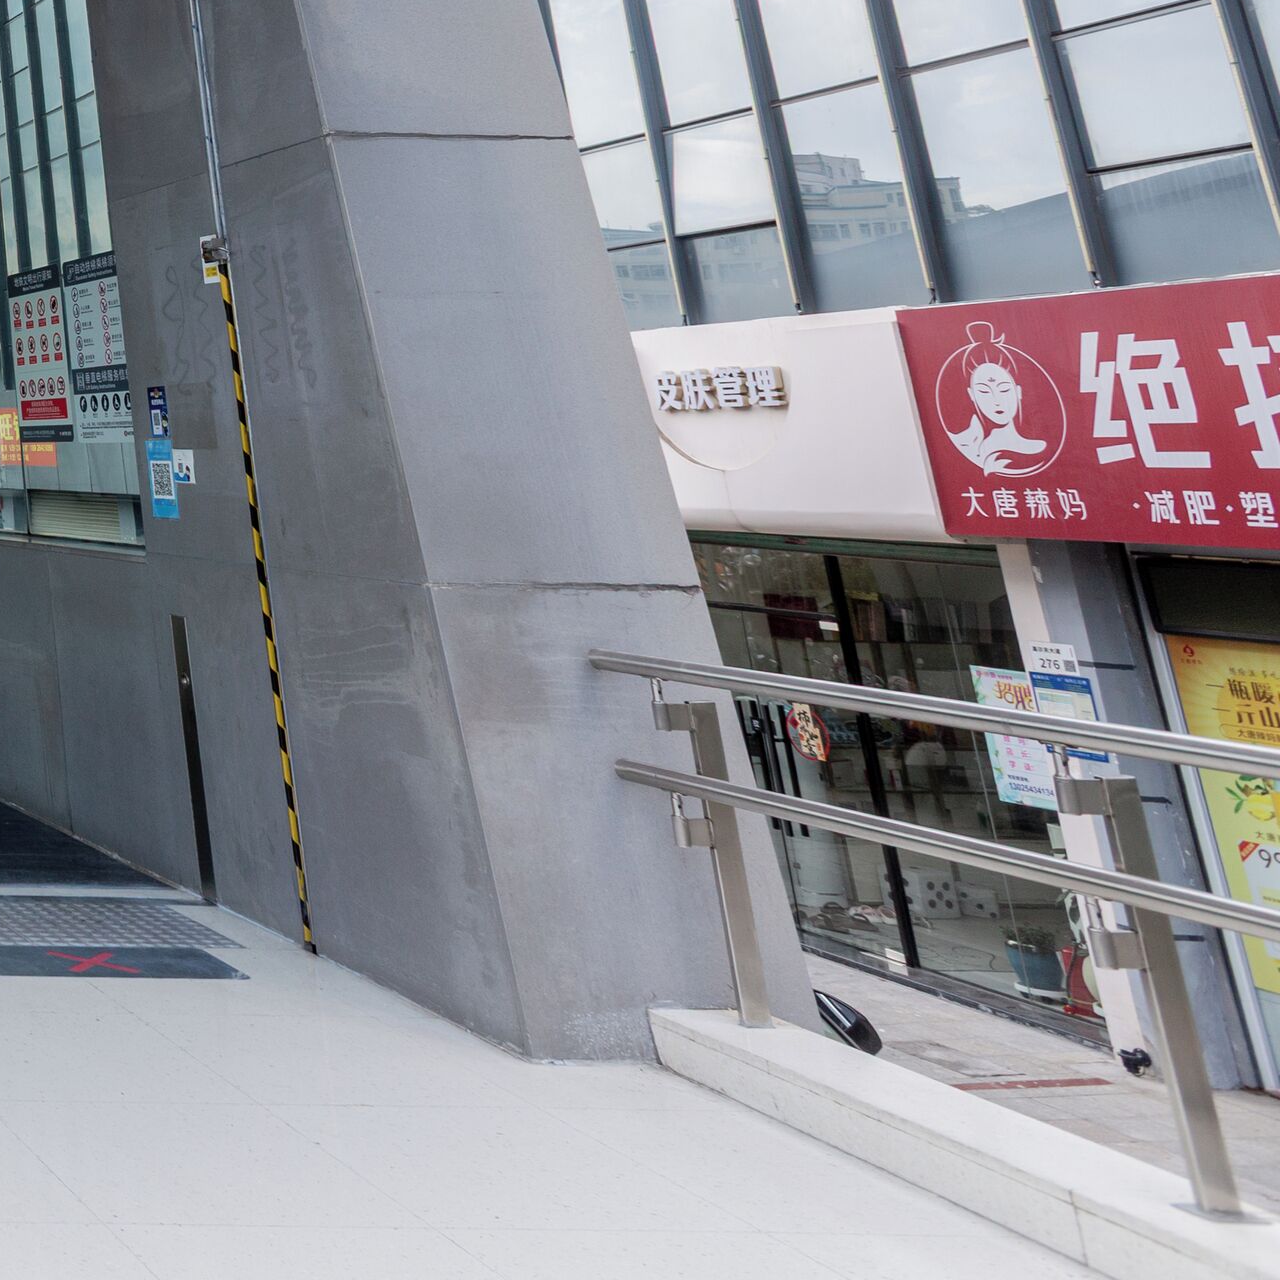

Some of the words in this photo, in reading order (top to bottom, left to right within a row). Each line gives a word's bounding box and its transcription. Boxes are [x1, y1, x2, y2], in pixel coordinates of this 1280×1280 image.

[74, 255, 117, 275] 自动扶梯乘梯须
[656, 367, 786, 412] 皮肤管理
[961, 486, 1087, 521] 大唐辣妈
[1039, 657, 1060, 670] 276
